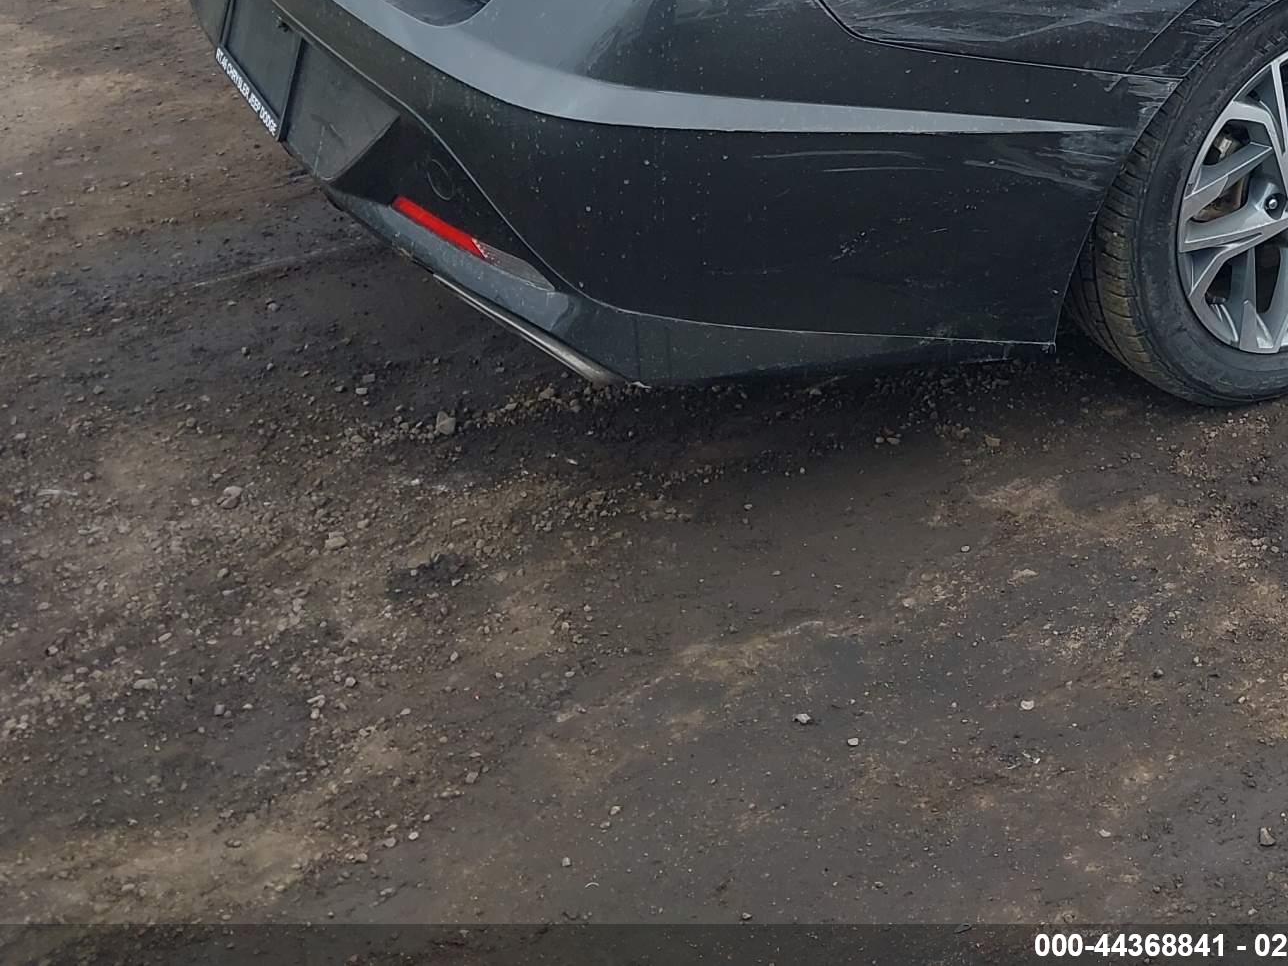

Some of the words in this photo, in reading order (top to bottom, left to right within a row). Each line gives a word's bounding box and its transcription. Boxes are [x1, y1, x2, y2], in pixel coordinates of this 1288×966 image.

[226, 62, 250, 100] CHRYSLER
[248, 92, 261, 113] JEEP
[259, 105, 278, 137] DODGE
